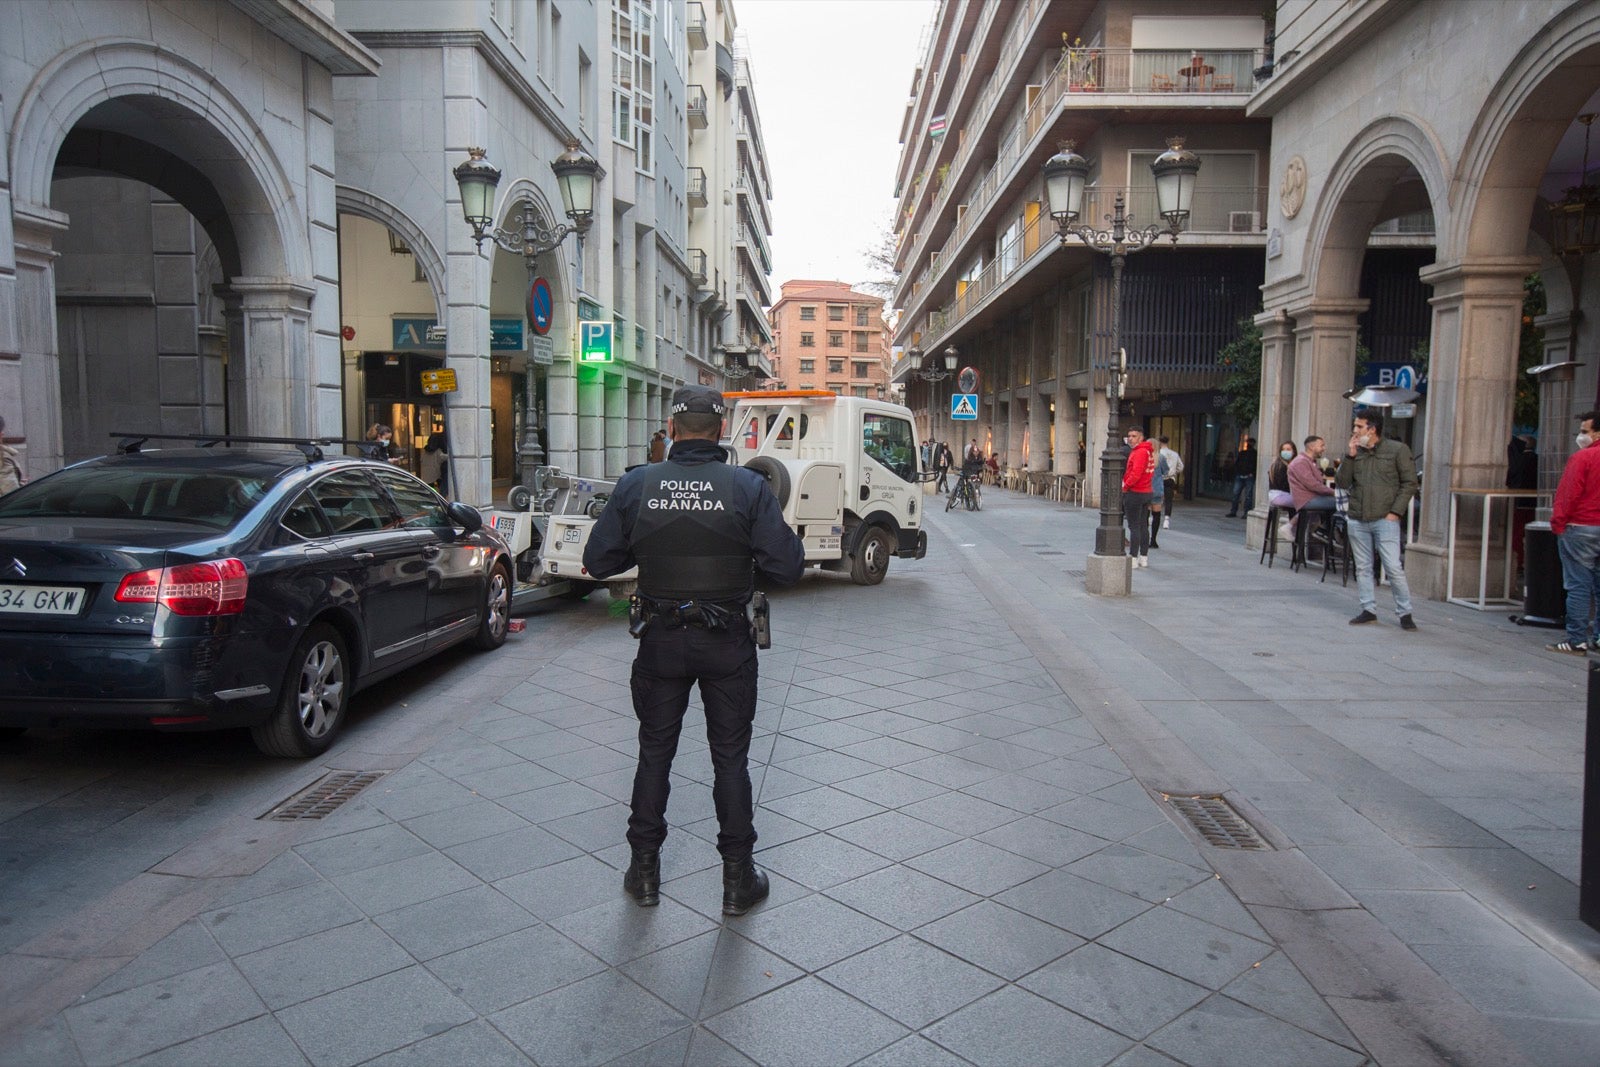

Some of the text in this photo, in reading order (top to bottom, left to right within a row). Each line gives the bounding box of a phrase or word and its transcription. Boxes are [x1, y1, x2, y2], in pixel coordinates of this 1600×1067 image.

[588, 324, 605, 347] P
[865, 472, 871, 485] 3
[660, 480, 714, 492] POLICIA
[671, 492, 700, 500] LOCAL
[647, 499, 725, 511] GRANADA
[565, 530, 578, 542] SP
[34, 591, 79, 610] GKW
[116, 615, 145, 624] C5
